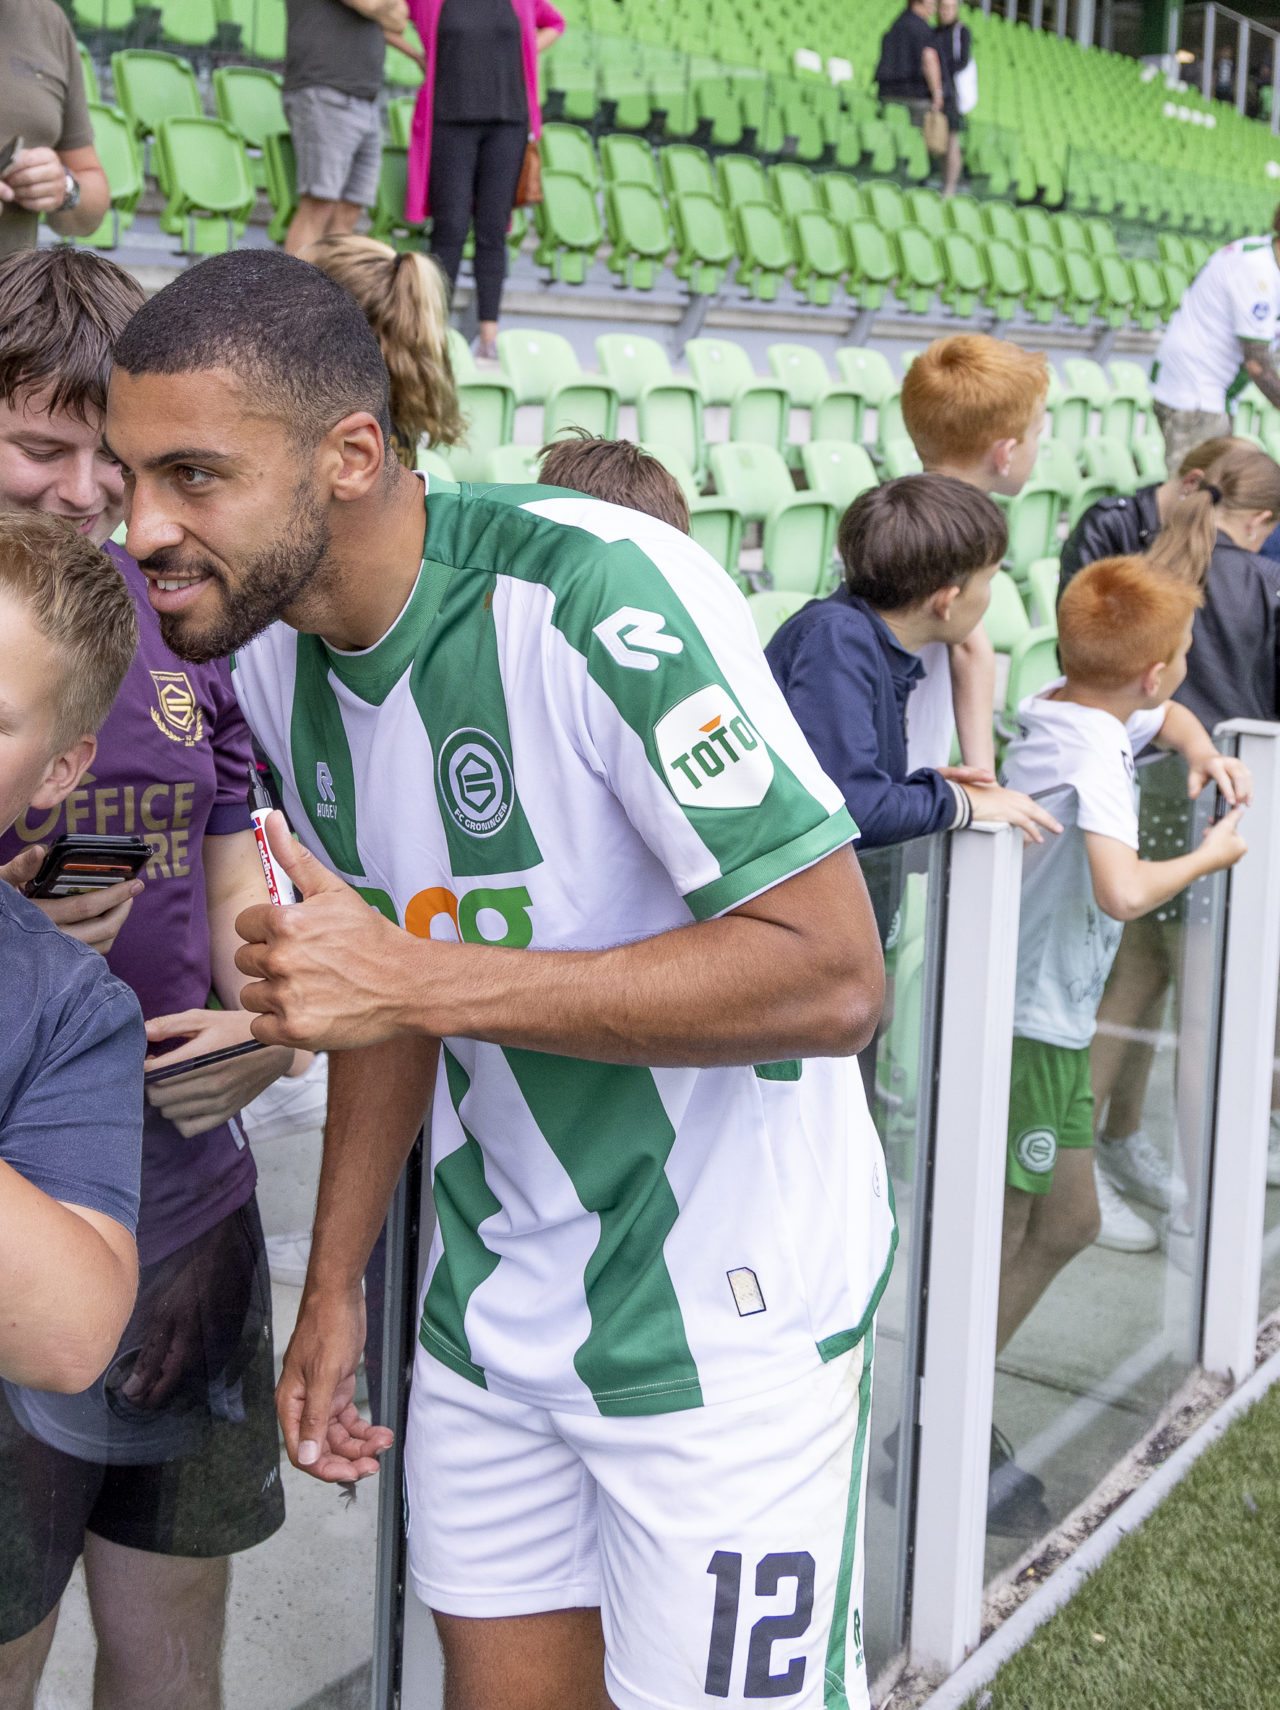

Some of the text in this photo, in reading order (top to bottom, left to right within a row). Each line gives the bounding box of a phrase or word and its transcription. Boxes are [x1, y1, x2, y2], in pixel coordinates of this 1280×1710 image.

[671, 715, 759, 790] TOTO
[14, 779, 195, 842] OFFICE
[454, 801, 508, 831] FC GRONINGEN
[705, 1550, 816, 1699] 12
